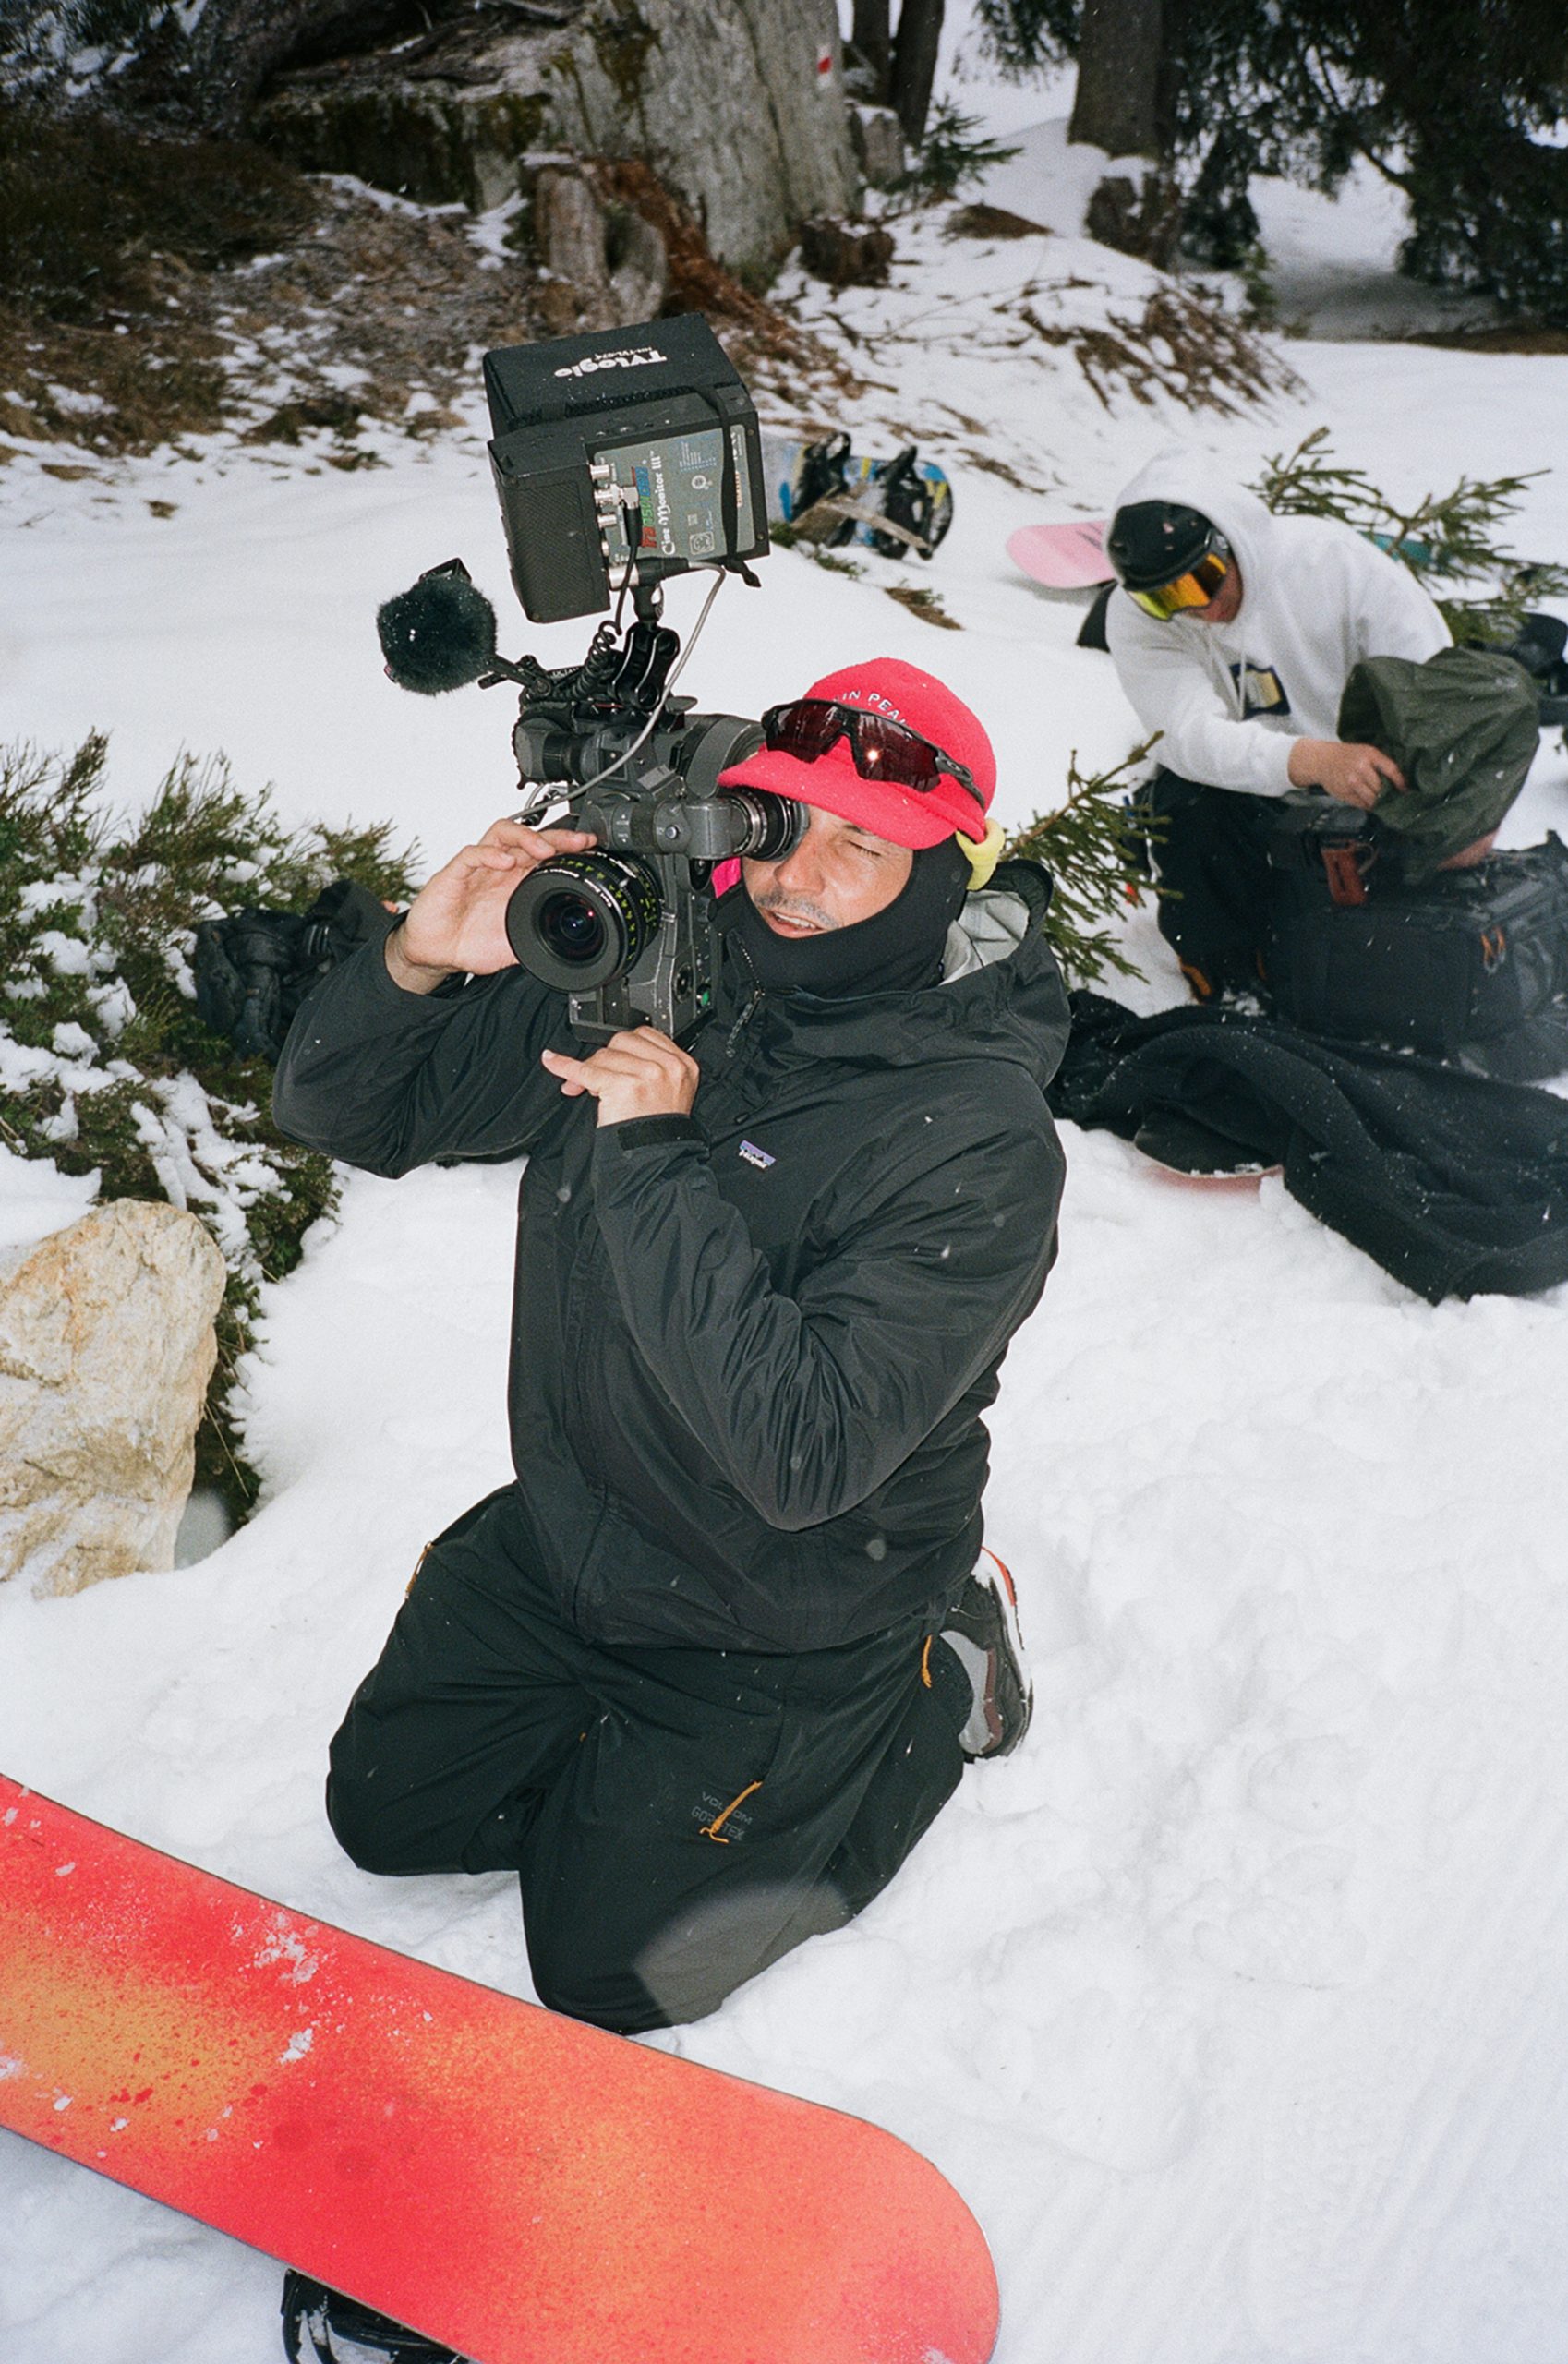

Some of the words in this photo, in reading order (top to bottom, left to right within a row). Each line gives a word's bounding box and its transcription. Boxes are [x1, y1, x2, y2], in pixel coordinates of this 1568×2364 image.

[654, 471, 670, 525] Monitor
[833, 689, 861, 702] IN
[702, 1791, 753, 1826] VOLOM
